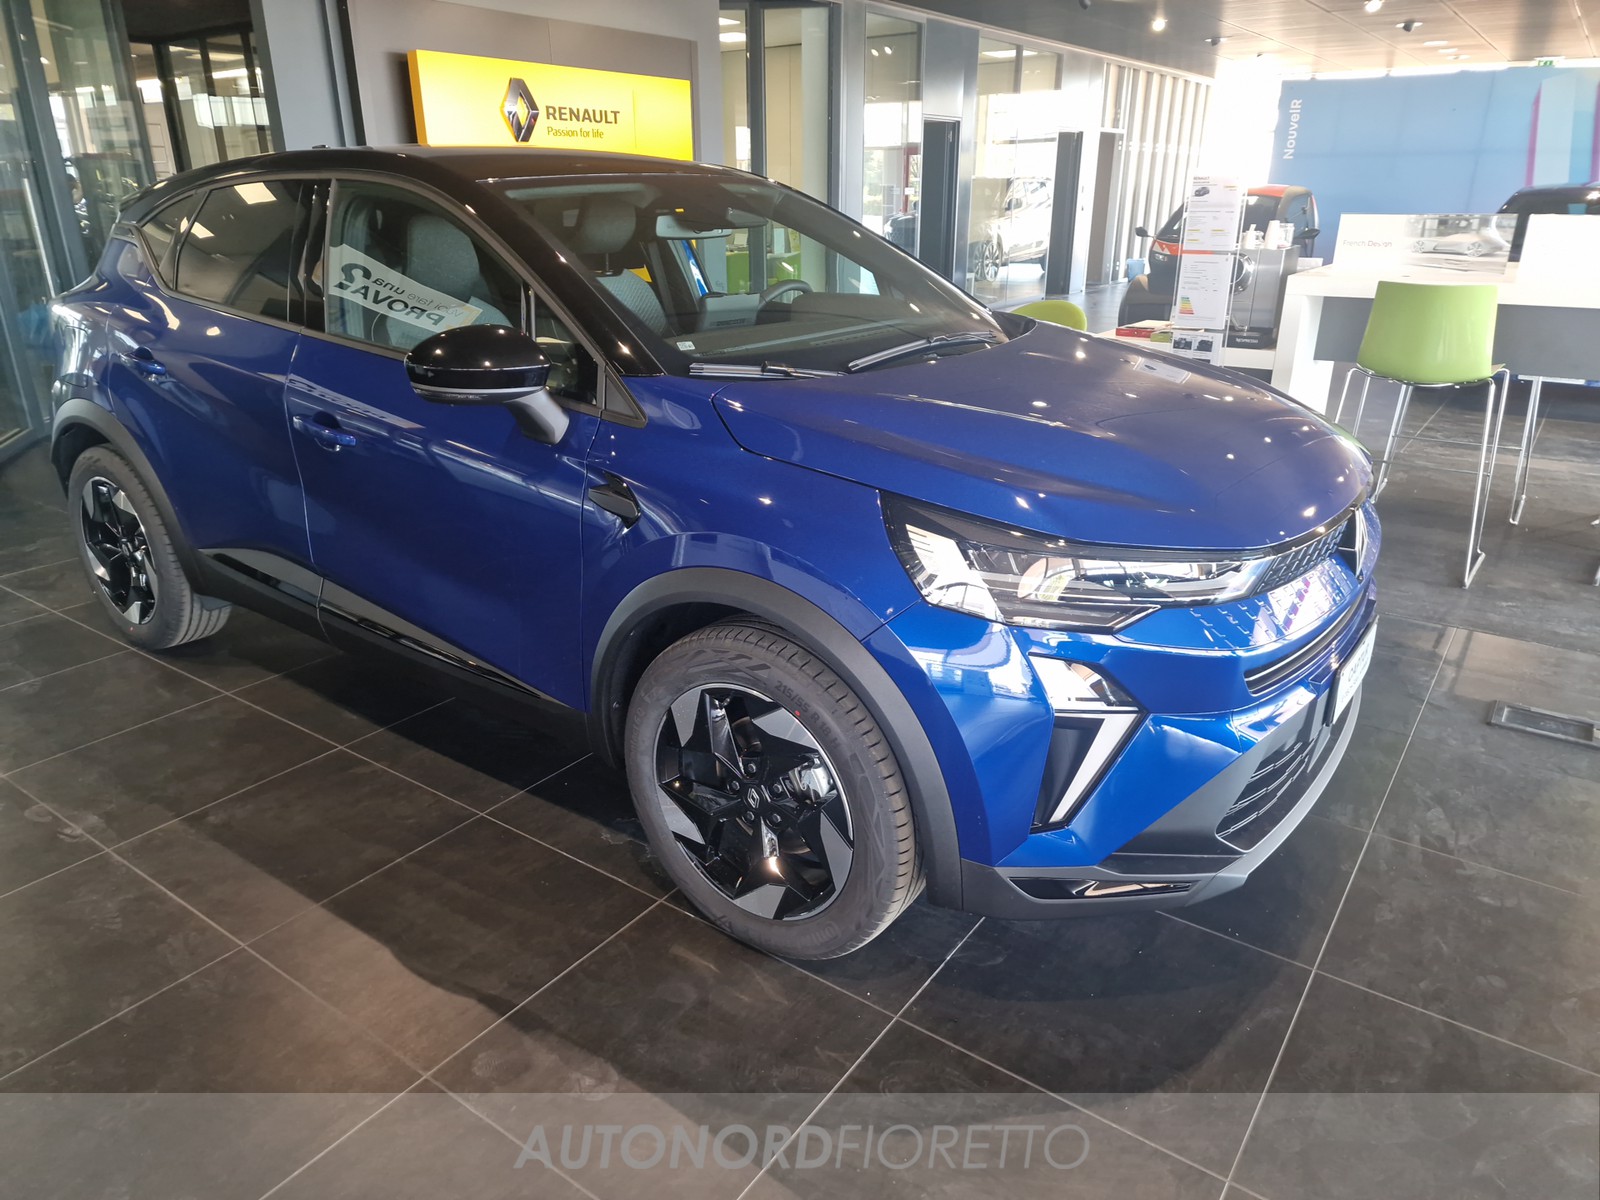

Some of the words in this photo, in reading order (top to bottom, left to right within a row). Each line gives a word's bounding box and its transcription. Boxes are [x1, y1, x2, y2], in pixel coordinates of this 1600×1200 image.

[545, 105, 620, 124] RENAULT
[547, 126, 578, 137] Passion
[580, 127, 590, 138] for
[592, 128, 604, 139] life
[1283, 99, 1303, 159] NouvelR
[774, 680, 811, 713] 215/55
